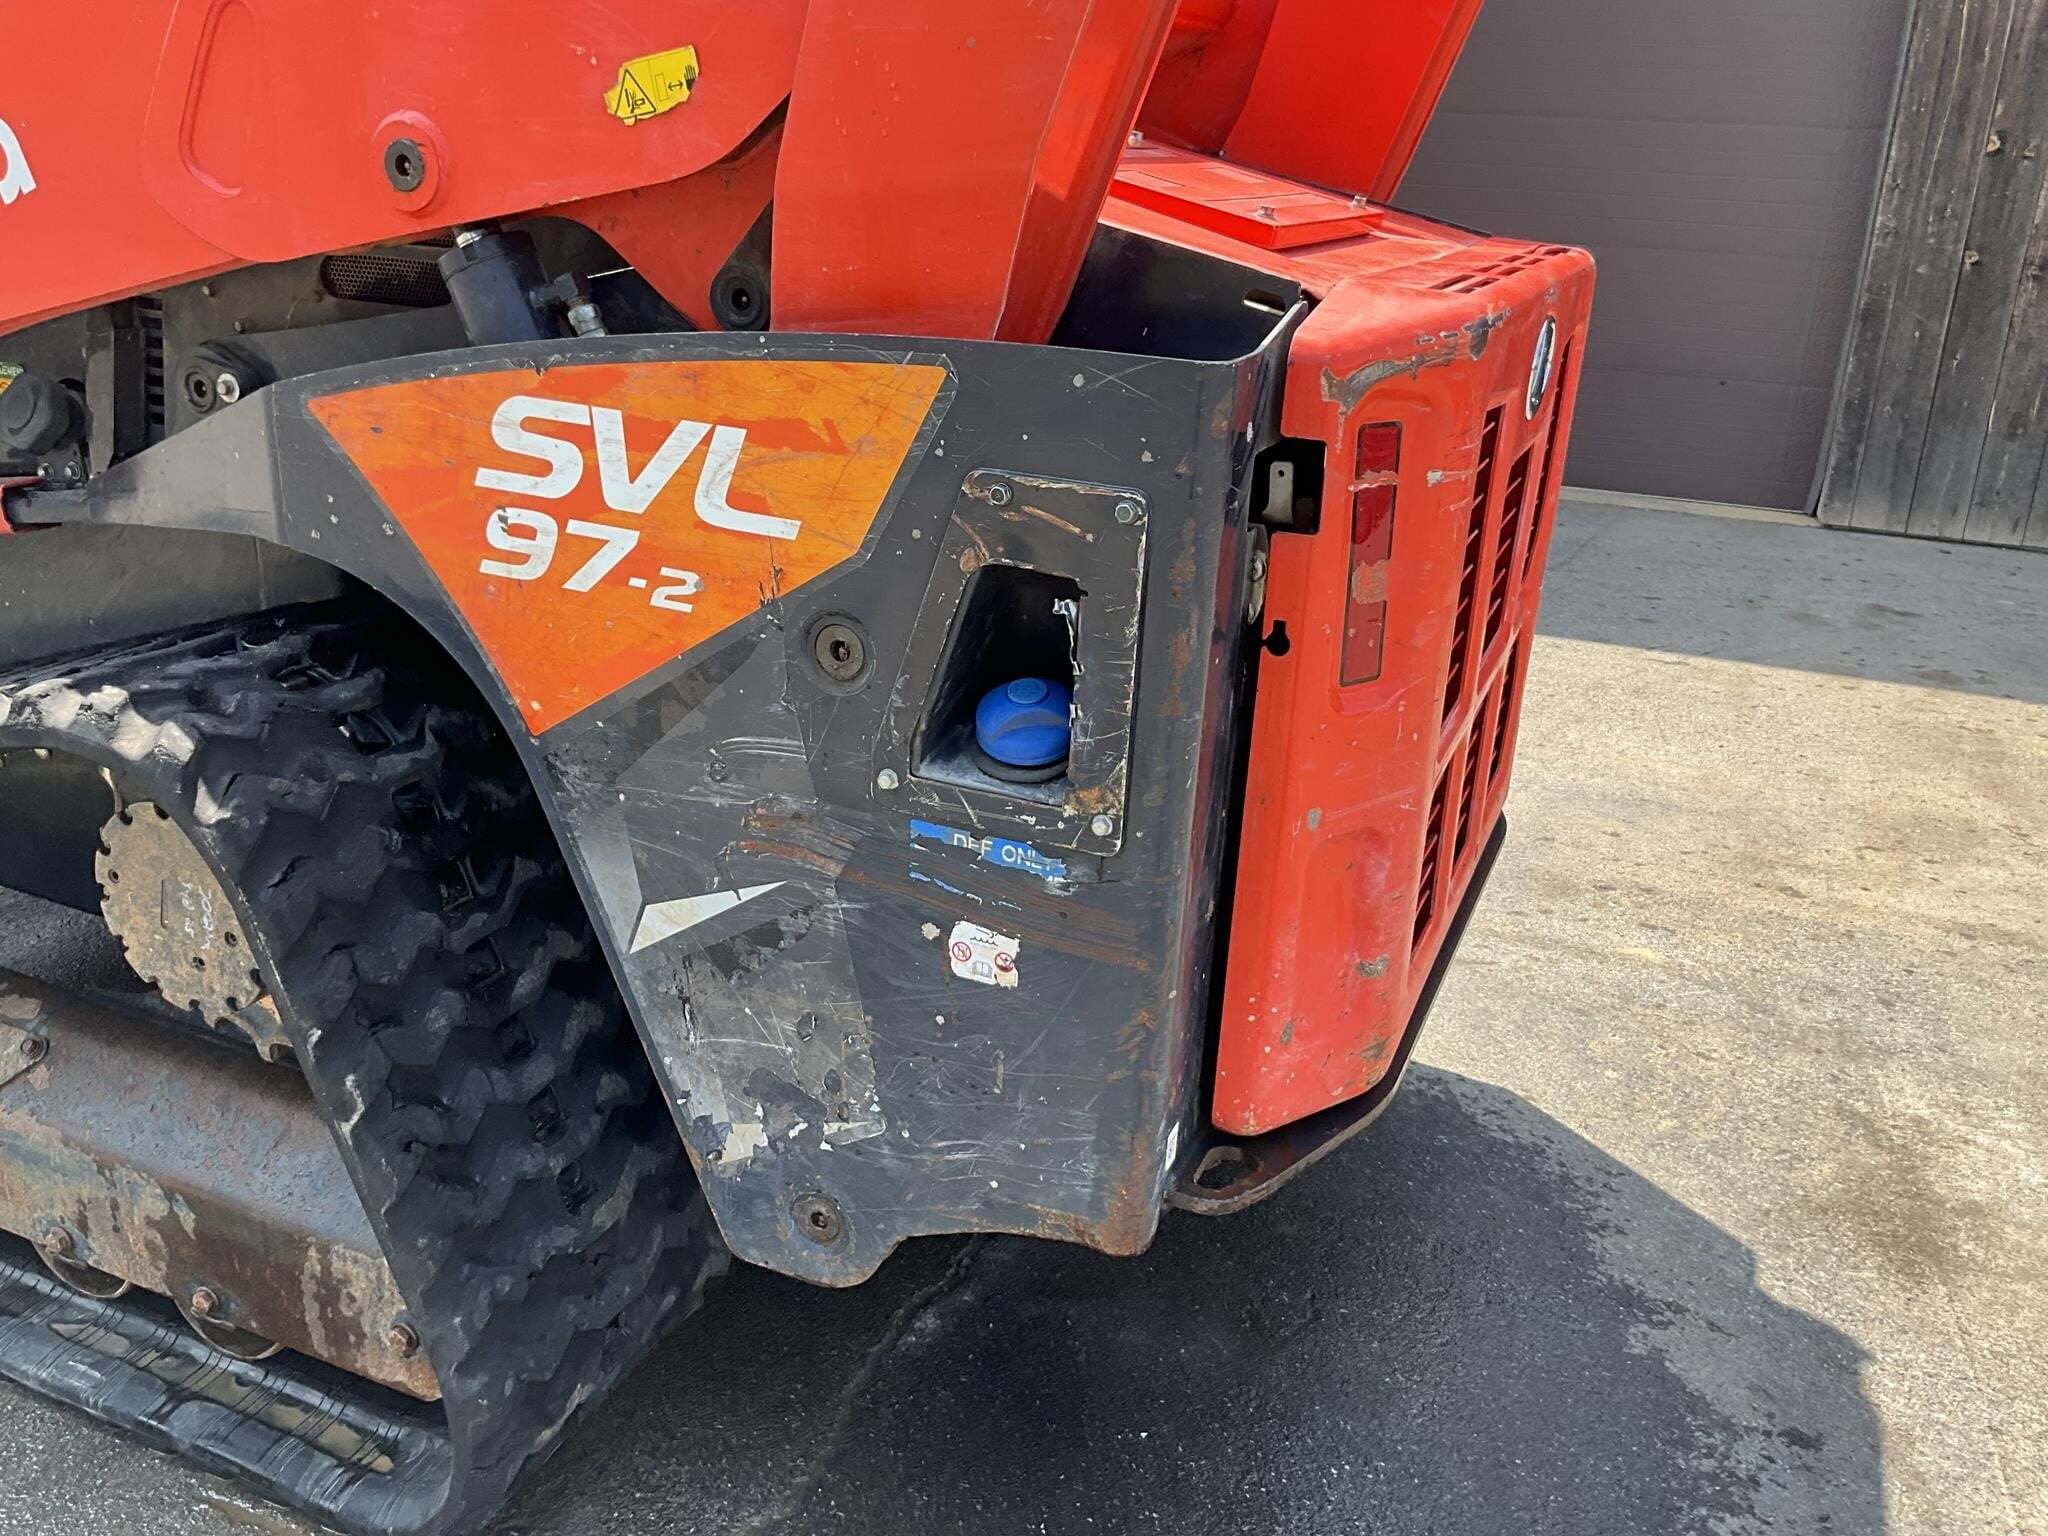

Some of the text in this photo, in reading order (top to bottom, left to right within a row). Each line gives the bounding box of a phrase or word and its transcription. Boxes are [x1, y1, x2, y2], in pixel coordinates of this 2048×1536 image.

[474, 395, 802, 541] SVL
[479, 507, 700, 613] 97-2
[1001, 844, 1051, 872] ONL
